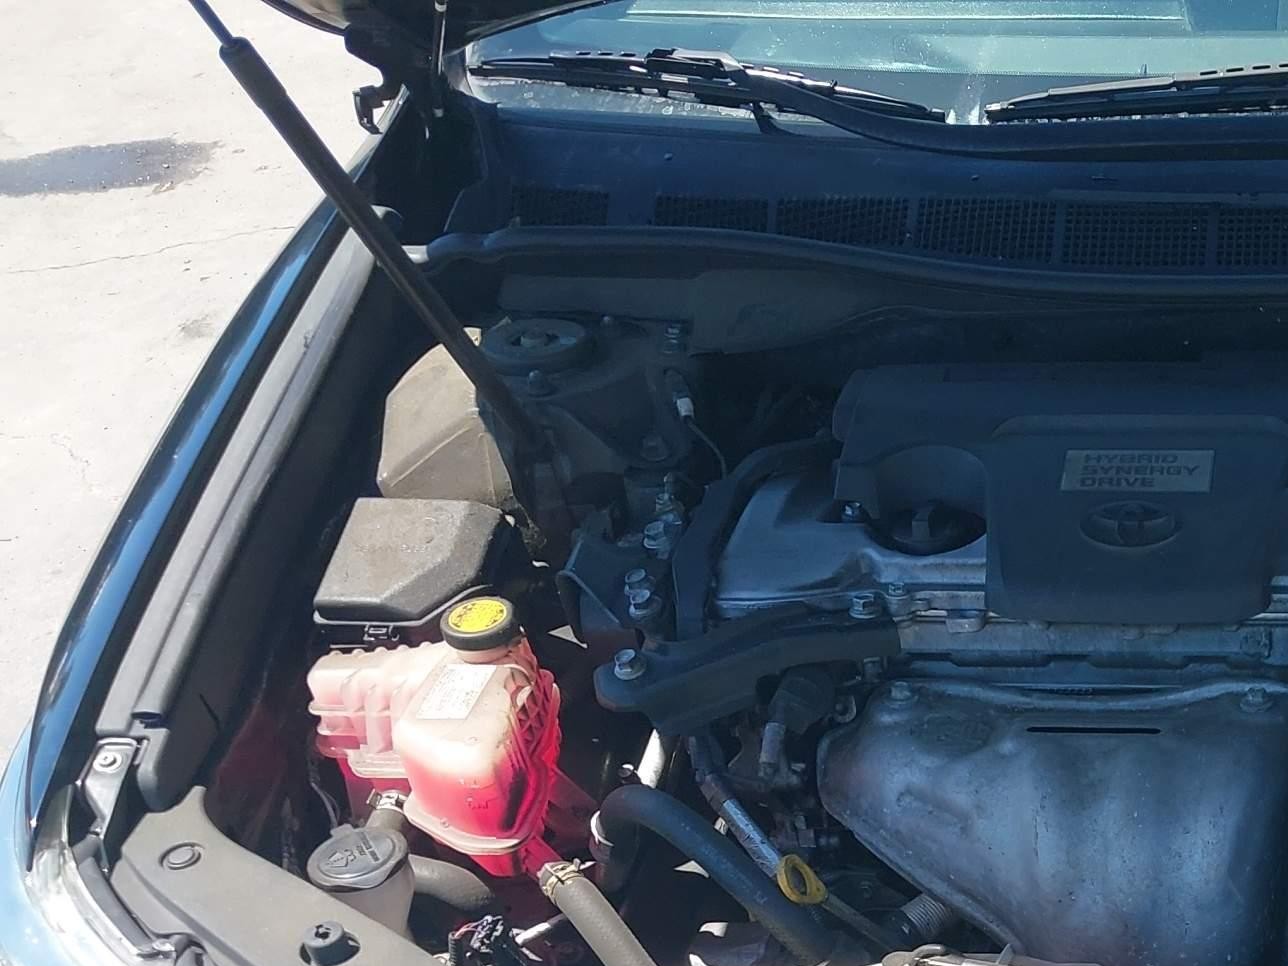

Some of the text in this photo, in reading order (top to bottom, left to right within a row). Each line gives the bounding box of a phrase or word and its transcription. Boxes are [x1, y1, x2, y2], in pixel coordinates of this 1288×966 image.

[1084, 453, 1179, 464] HYBRID
[1080, 464, 1201, 476] SYNERGY
[1080, 476, 1156, 488] DRIVE
